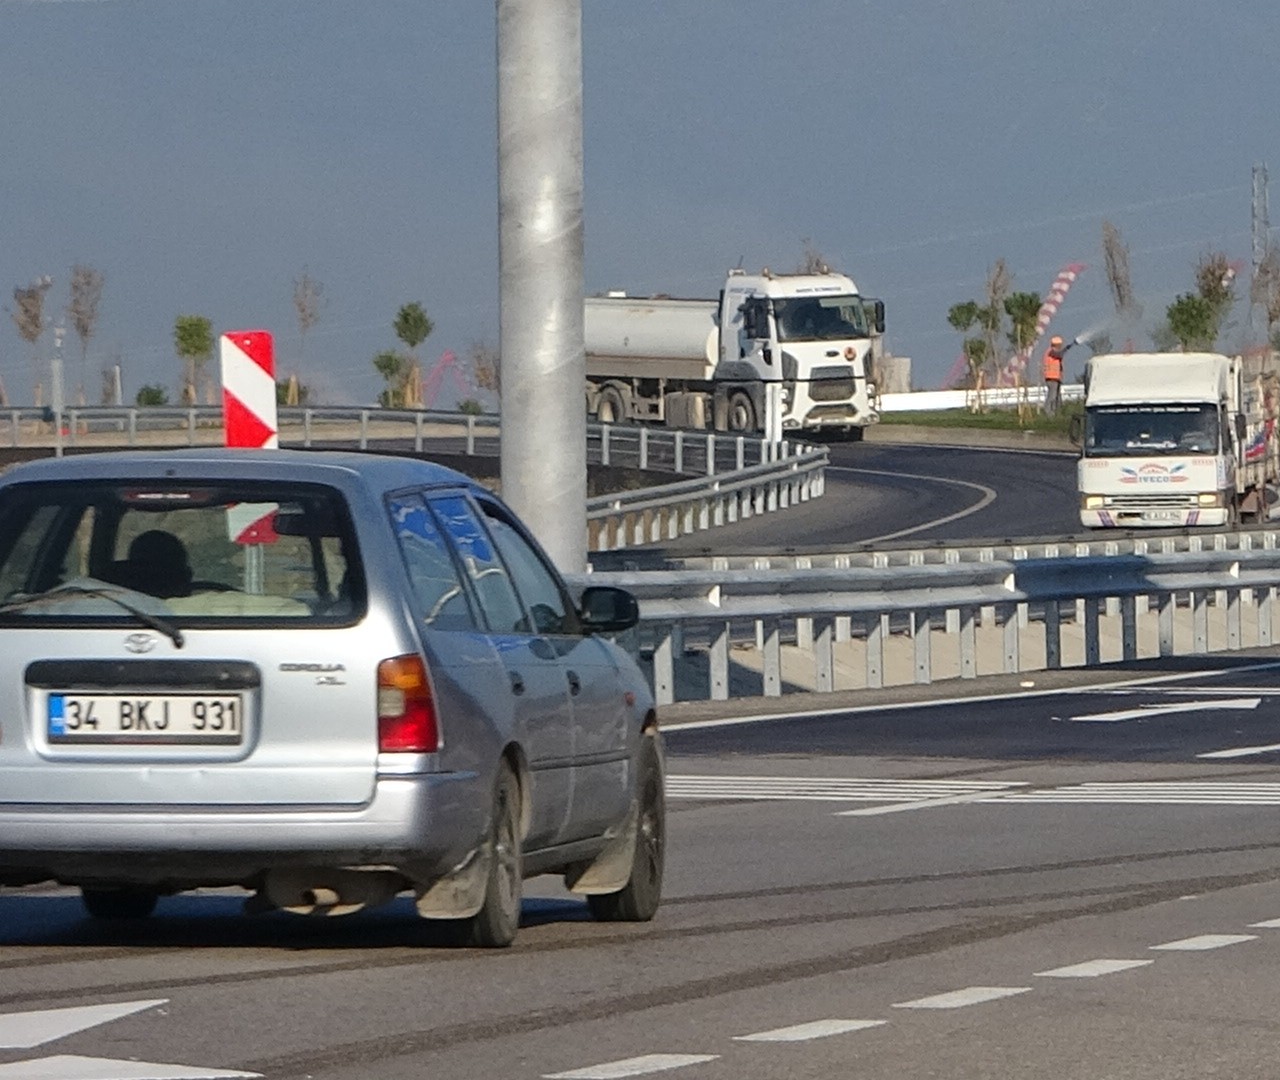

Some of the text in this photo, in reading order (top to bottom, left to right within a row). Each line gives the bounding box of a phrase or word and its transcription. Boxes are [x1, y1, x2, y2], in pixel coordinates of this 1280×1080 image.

[1138, 475, 1170, 483] IVECO
[67, 700, 236, 730] 34 BKJ 931
